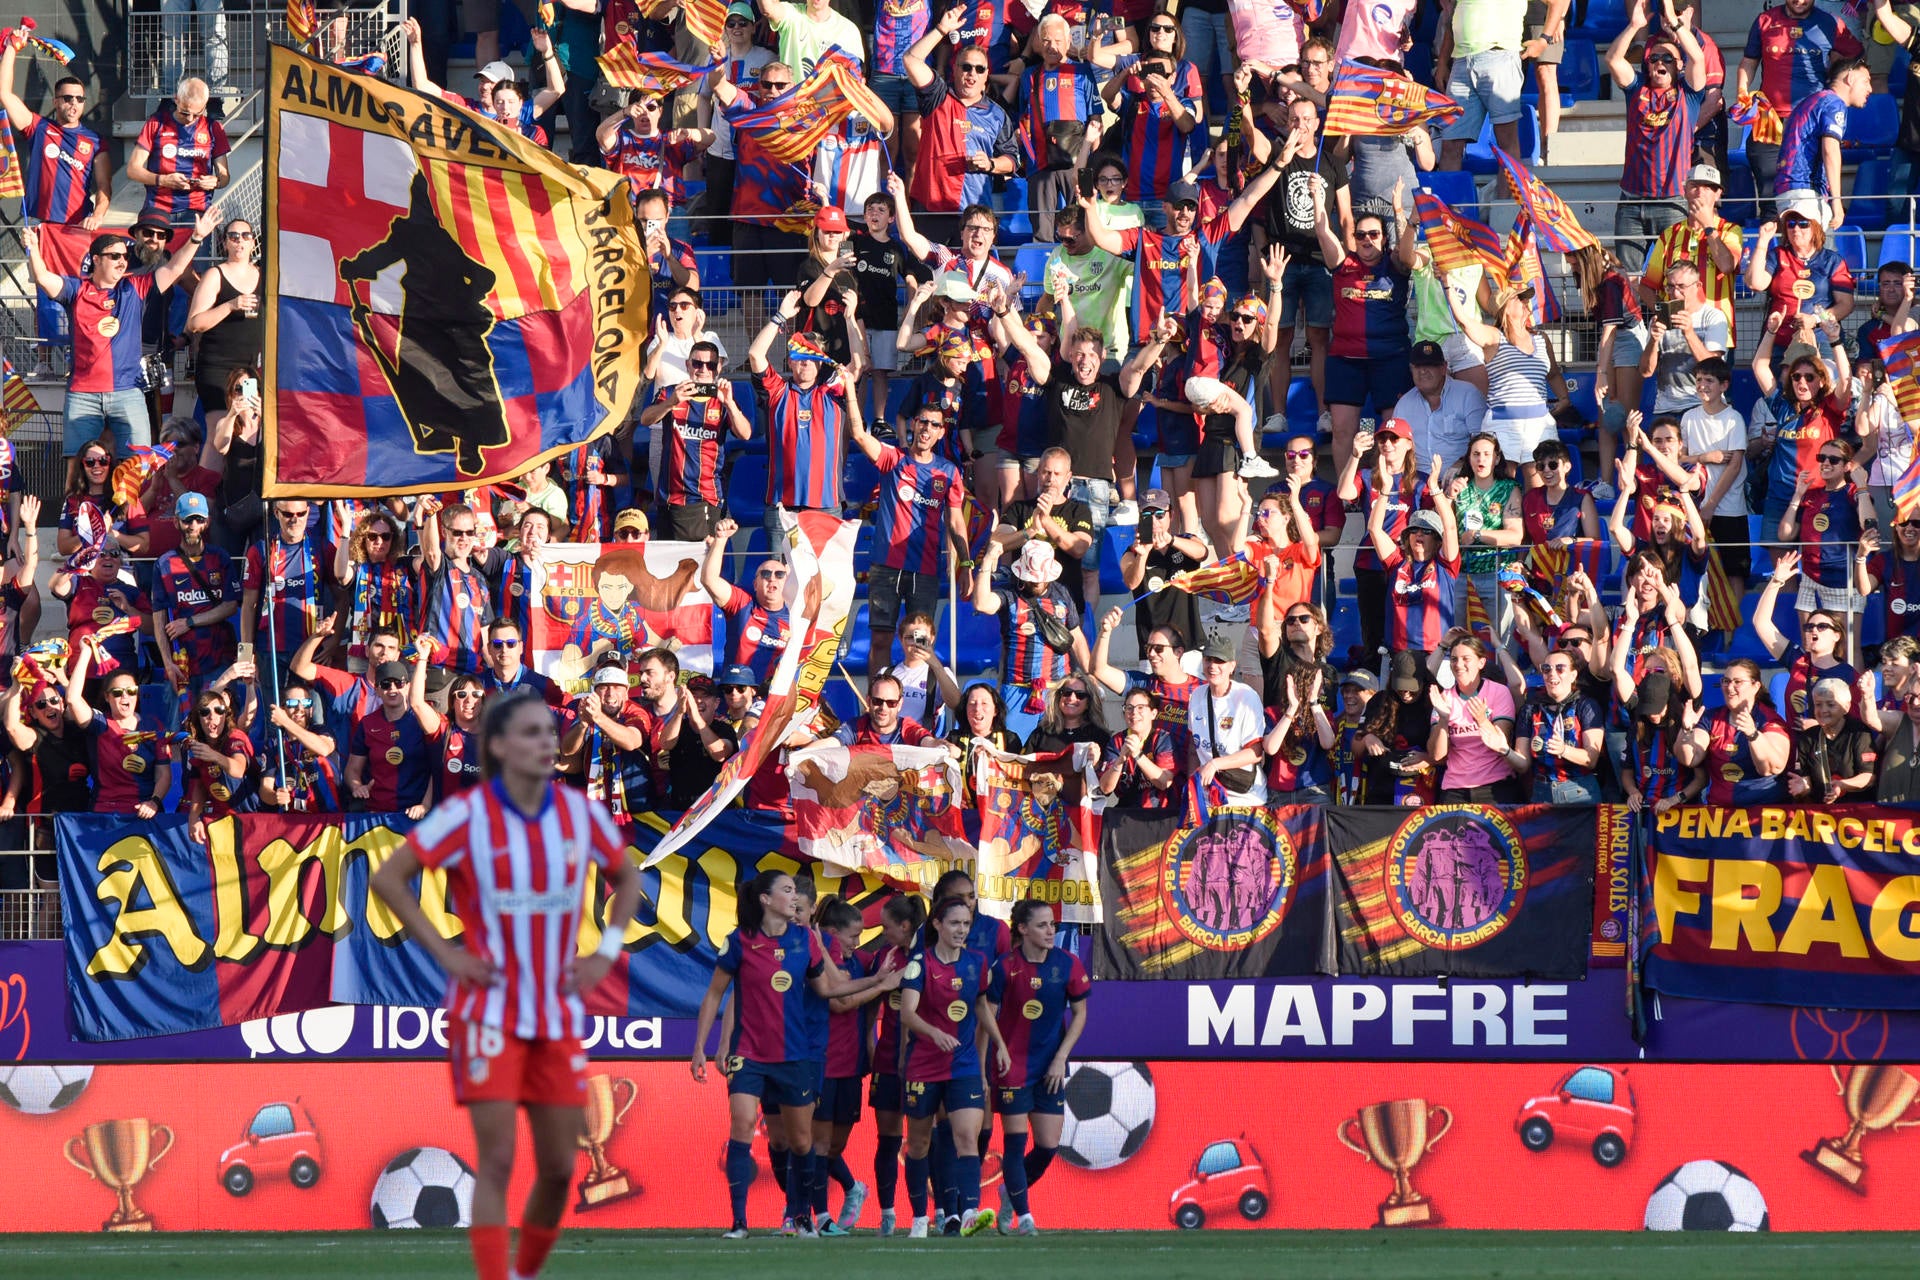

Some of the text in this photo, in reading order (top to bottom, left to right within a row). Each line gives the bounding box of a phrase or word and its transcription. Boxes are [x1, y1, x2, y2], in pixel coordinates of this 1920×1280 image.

[960, 28, 989, 40] Spotify
[177, 148, 208, 159] Spotify
[867, 264, 892, 278] Spotify
[1075, 281, 1102, 294] Spotify
[912, 493, 941, 509] Spotify
[1164, 869, 1176, 891] PB
[1253, 808, 1279, 834] FEM
[1275, 833, 1296, 888] FORÇA
[1389, 804, 1525, 891] PB TOTES UNIDES FEM FORÇA
[1609, 867, 1629, 913] SOLES
[1178, 914, 1224, 948] BARÇA
[1401, 910, 1448, 947] BARÇA
[1187, 984, 1569, 1047] MAPFRE
